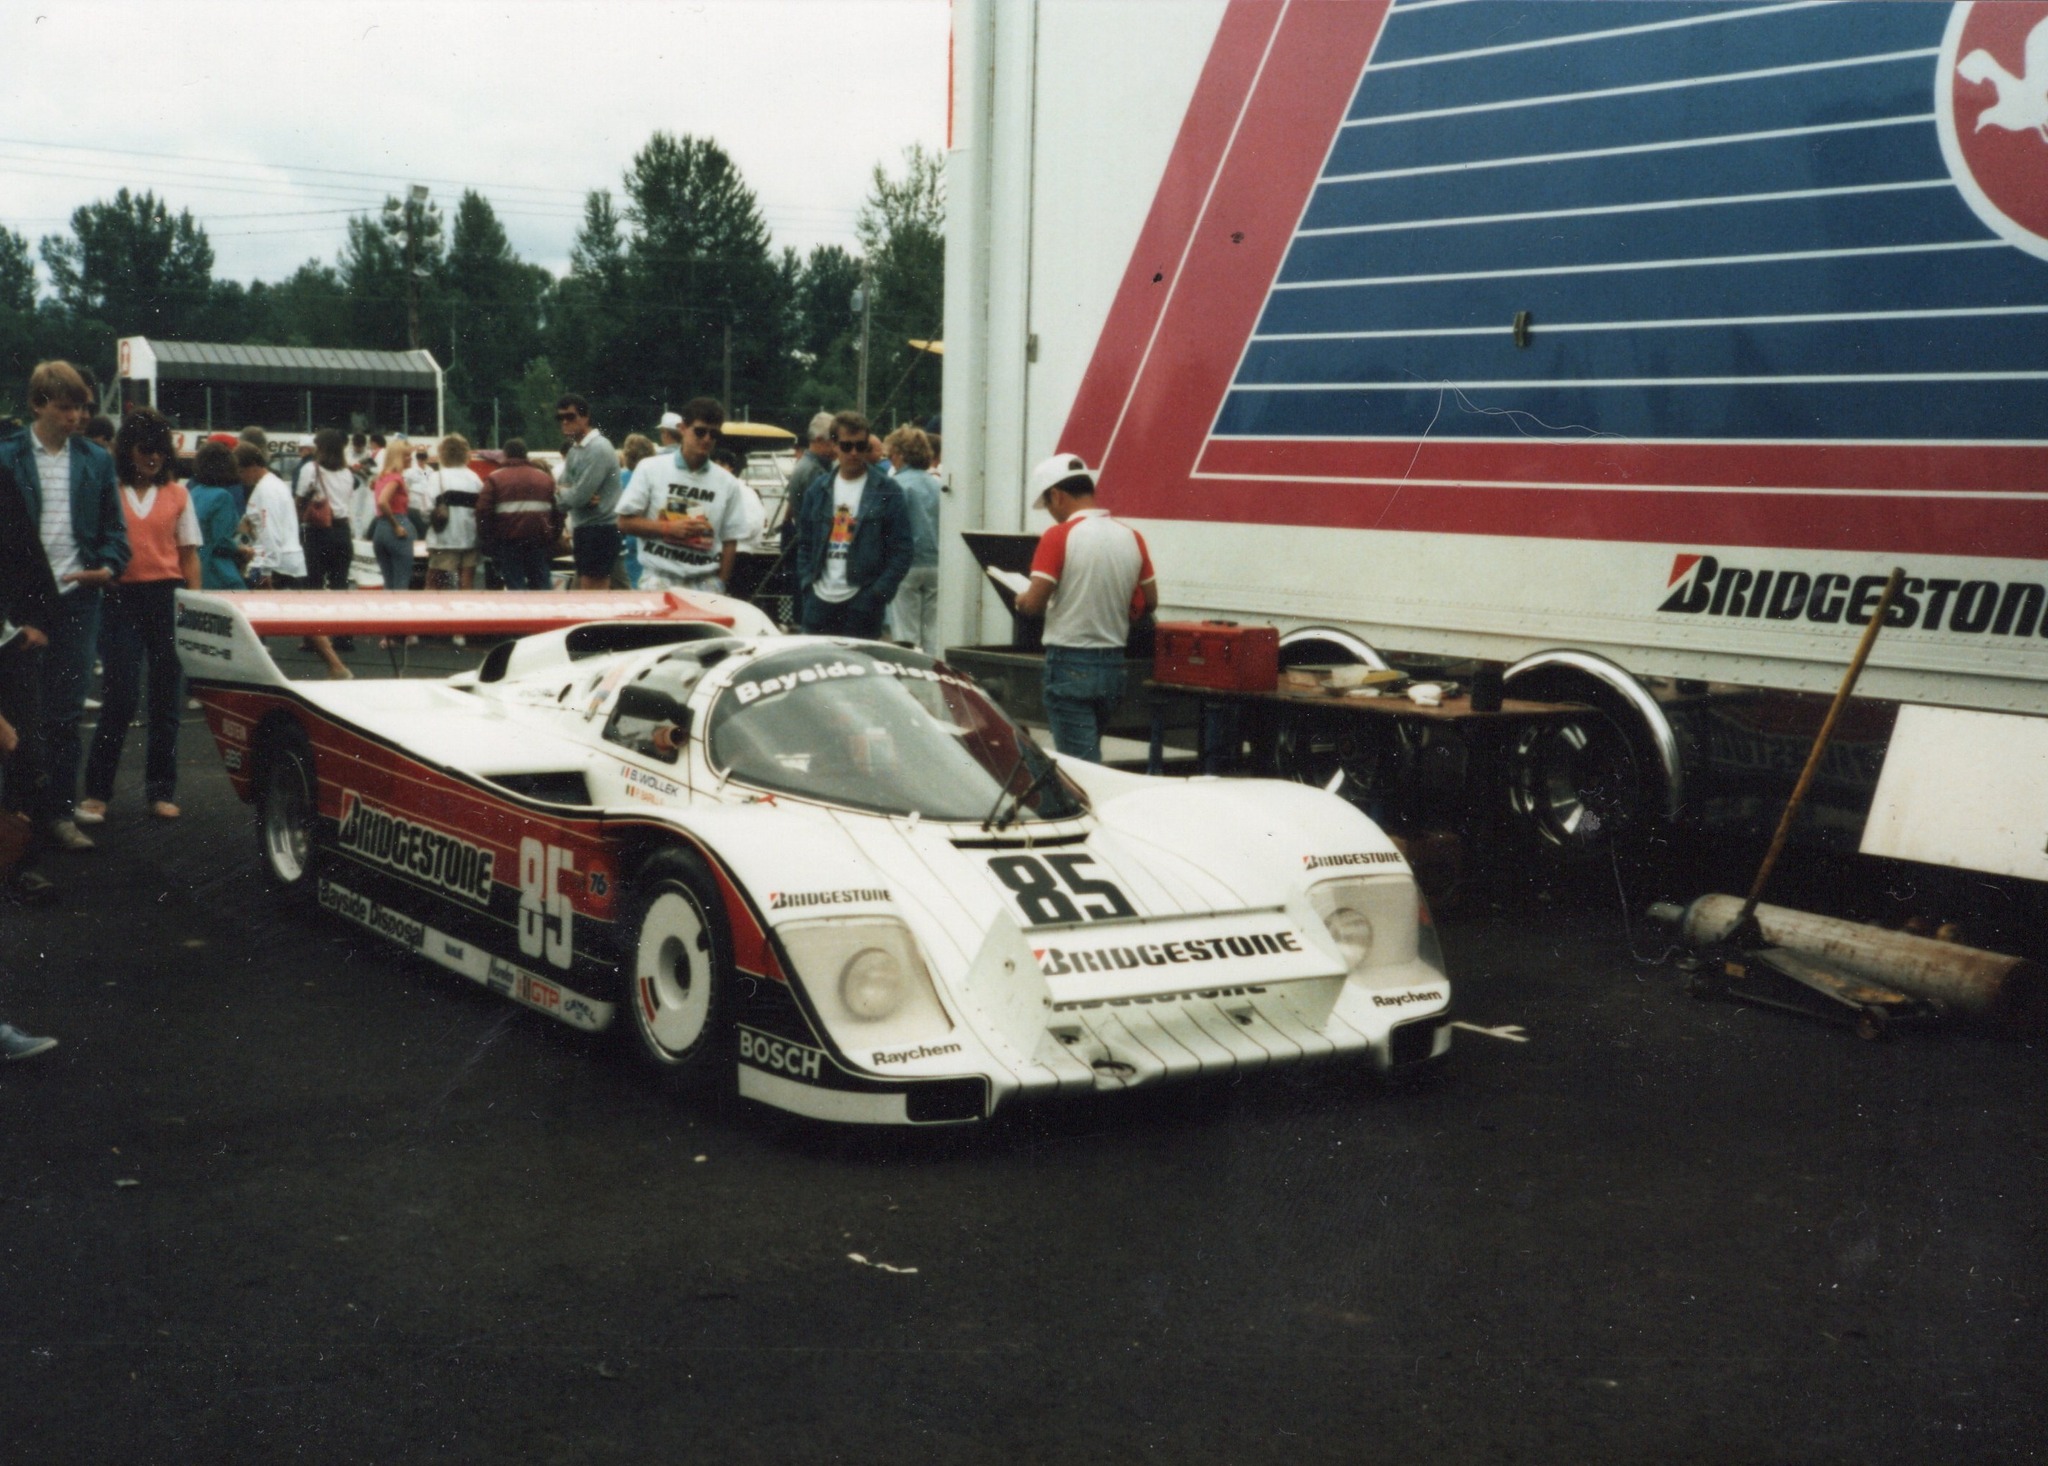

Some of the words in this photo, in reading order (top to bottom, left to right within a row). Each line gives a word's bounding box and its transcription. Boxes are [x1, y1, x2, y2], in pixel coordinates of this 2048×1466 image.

[668, 484, 715, 502] TEAM
[1656, 554, 2048, 638] BRIDGESTON
[735, 661, 865, 704] Bayside
[339, 789, 494, 904] BRIDGESTONE
[1303, 852, 1403, 870] BRIDGESTONE
[590, 872, 607, 896] 76
[769, 889, 892, 909] BRIDGESTONE
[987, 853, 1139, 925] 85
[518, 836, 574, 969] 85
[1034, 931, 1303, 976] BRIDGESTONE
[531, 980, 560, 1008] GTP
[1372, 990, 1443, 1007] Raychem
[741, 1030, 820, 1079] BOSCH
[872, 1042, 962, 1066] Raychem
